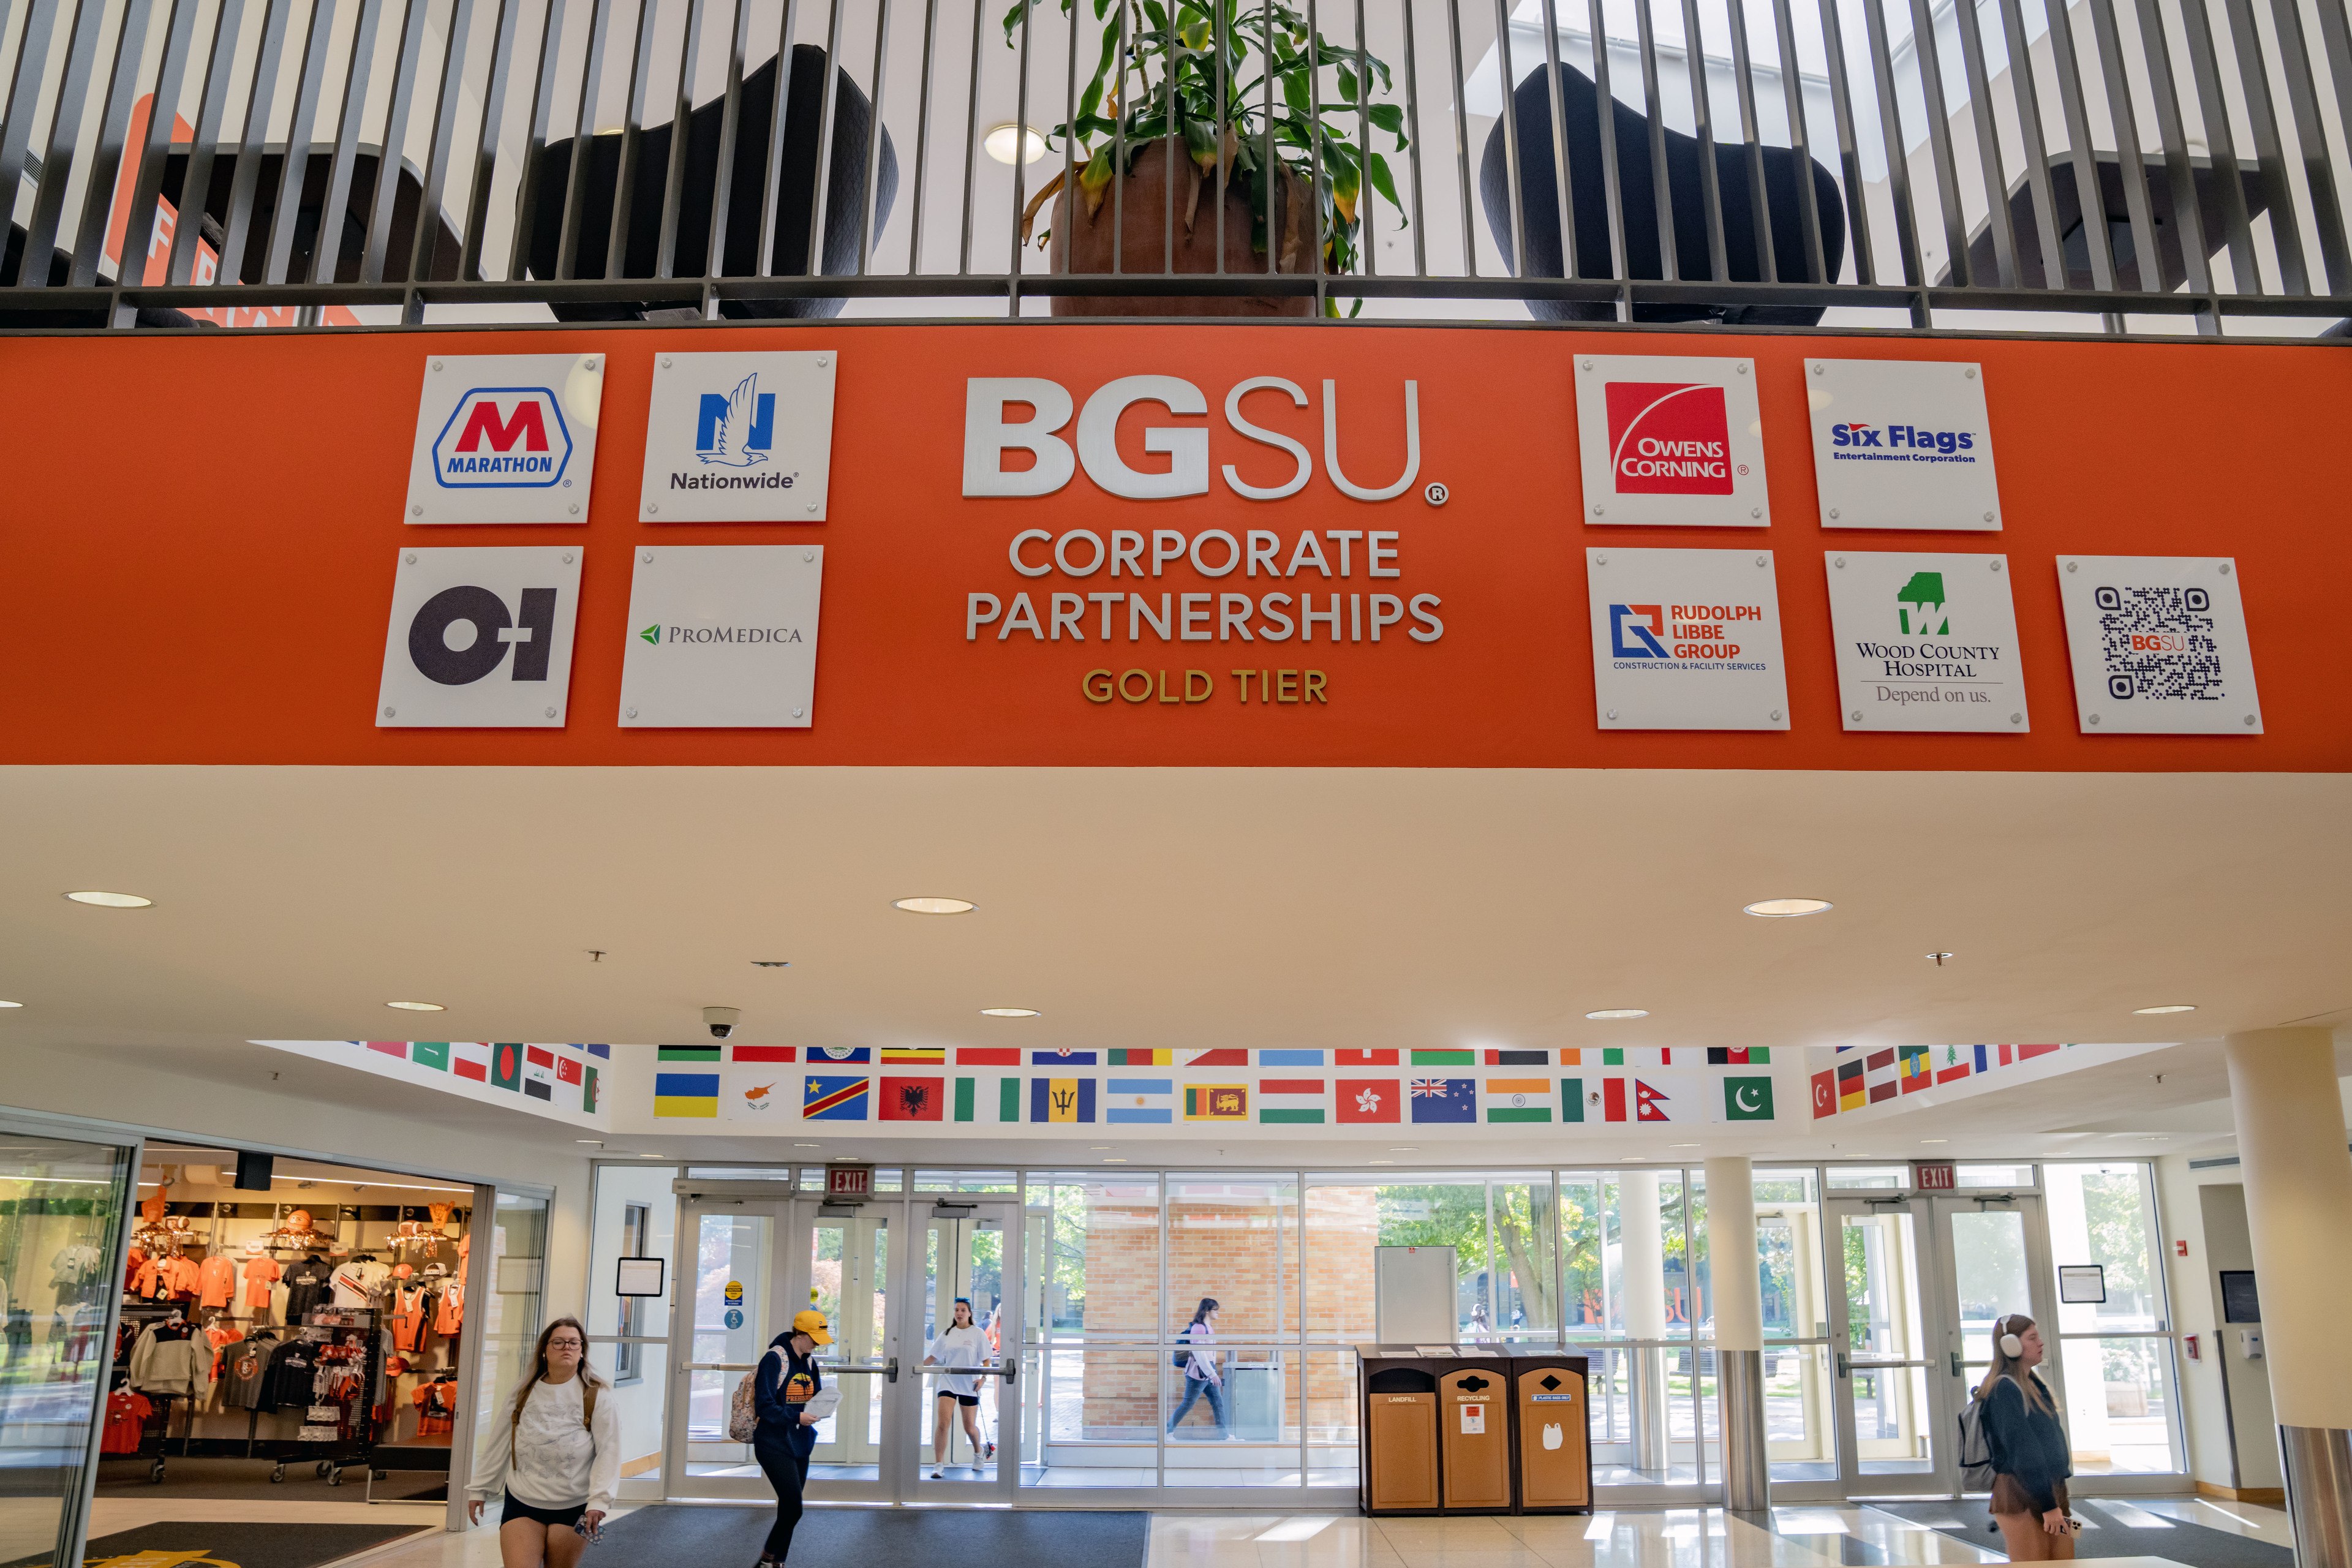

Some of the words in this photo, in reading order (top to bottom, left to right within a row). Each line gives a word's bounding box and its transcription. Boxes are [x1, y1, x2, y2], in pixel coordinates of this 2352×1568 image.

[454, 401, 549, 453] M
[1832, 423, 1883, 447] Six
[1637, 437, 1724, 458] OWENS
[447, 457, 552, 473] MARATHON
[1833, 452, 1910, 461] Entertainment
[1912, 454, 1976, 464] Corporation
[1621, 458, 1726, 478] CORNING
[1009, 529, 1401, 578] CORPORATE
[966, 592, 1444, 643] PARTNERSHIPS
[1671, 605, 1762, 621] RUDOLPH
[1673, 624, 1725, 640] LIBBE
[1674, 643, 1741, 660] GROUP
[1856, 643, 1915, 659] WOOD
[1920, 643, 2000, 660] COUNTY
[2132, 635, 2184, 651] BGSU
[1727, 663, 1766, 671] SERVICES
[1883, 660, 1977, 677] HOSPITAL
[1082, 669, 1213, 703] GOLD
[1231, 669, 1328, 703] TIER
[1877, 685, 1940, 706] Depend
[1944, 691, 1965, 703] on
[1969, 692, 1991, 703] us.
[835, 1172, 865, 1191] EXIT
[1921, 1167, 1949, 1188] EXIT
